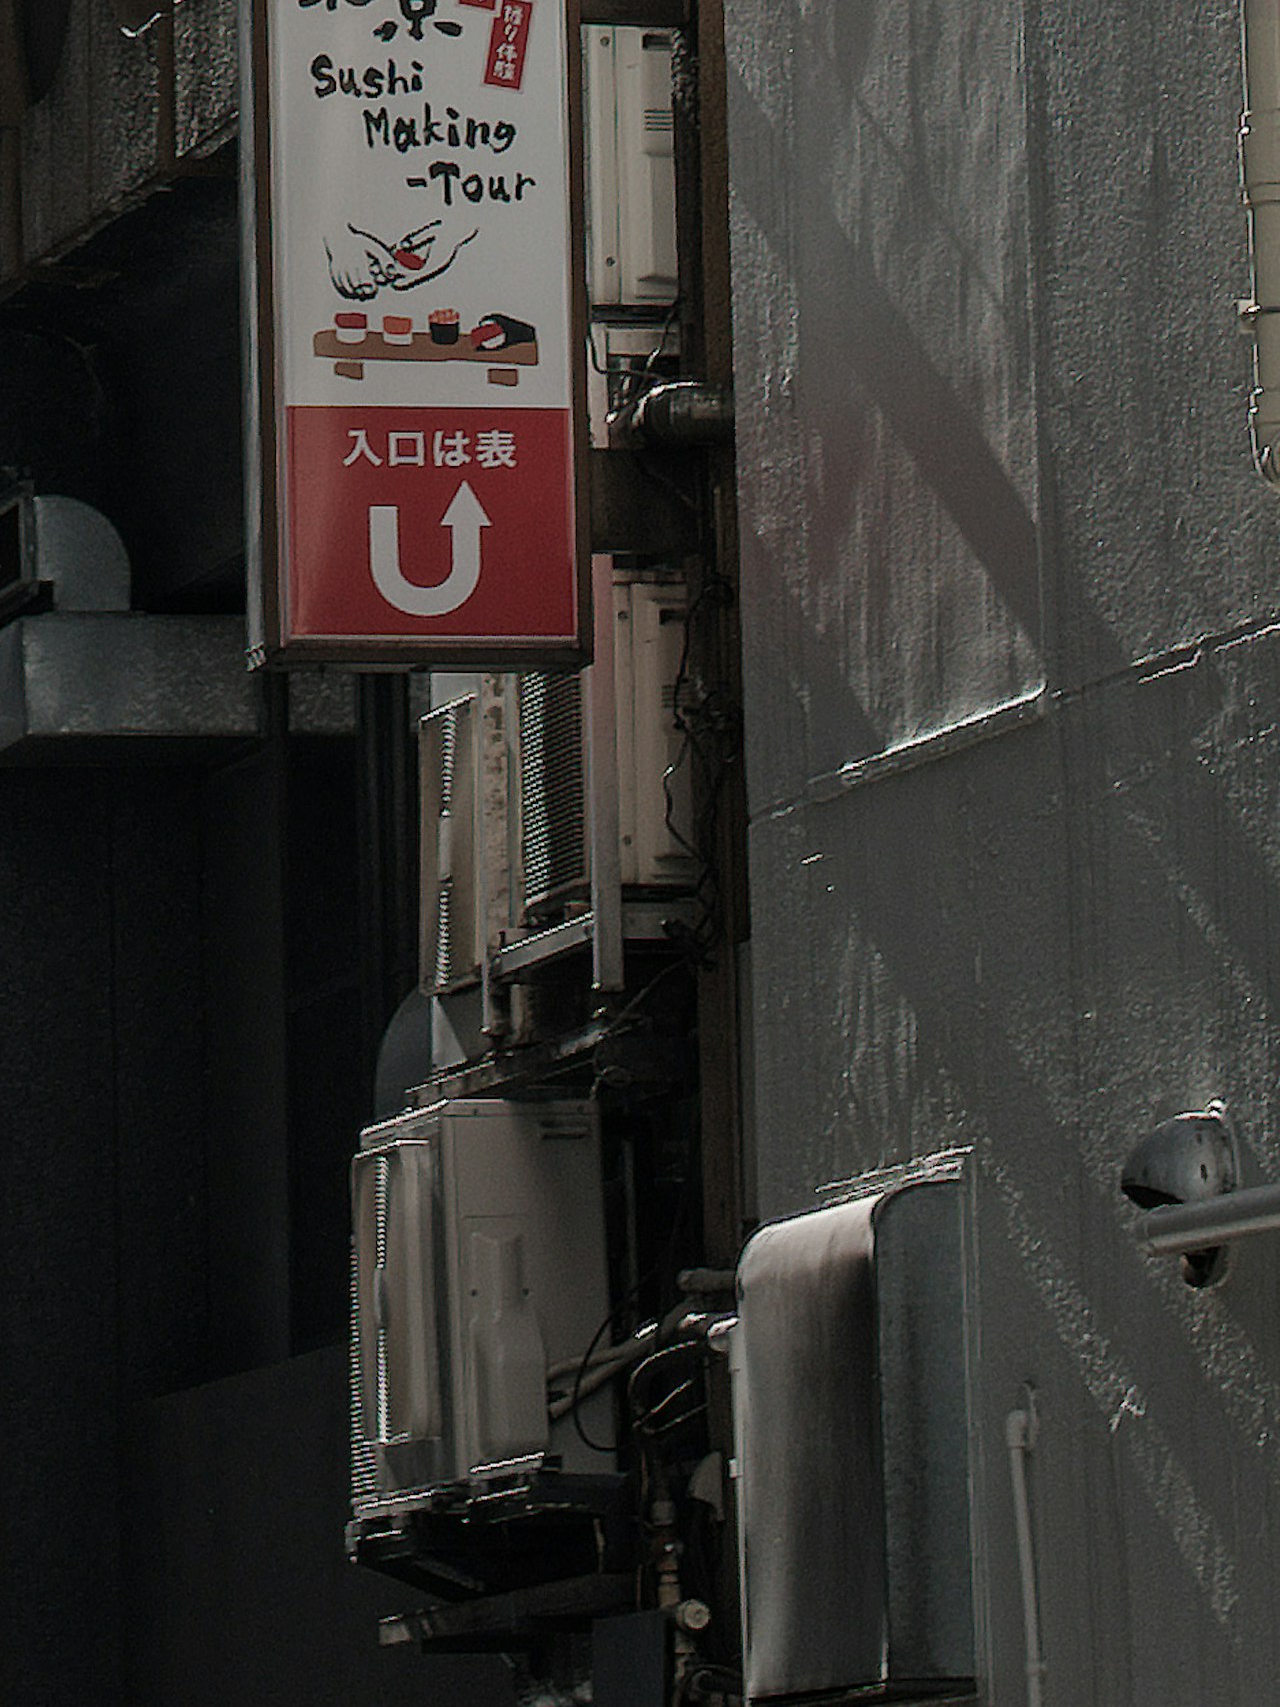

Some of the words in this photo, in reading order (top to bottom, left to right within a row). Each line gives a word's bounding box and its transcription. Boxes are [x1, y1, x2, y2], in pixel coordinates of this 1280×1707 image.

[310, 53, 424, 99] Sushi
[362, 102, 516, 153] Making
[342, 429, 517, 469] 入口は表
